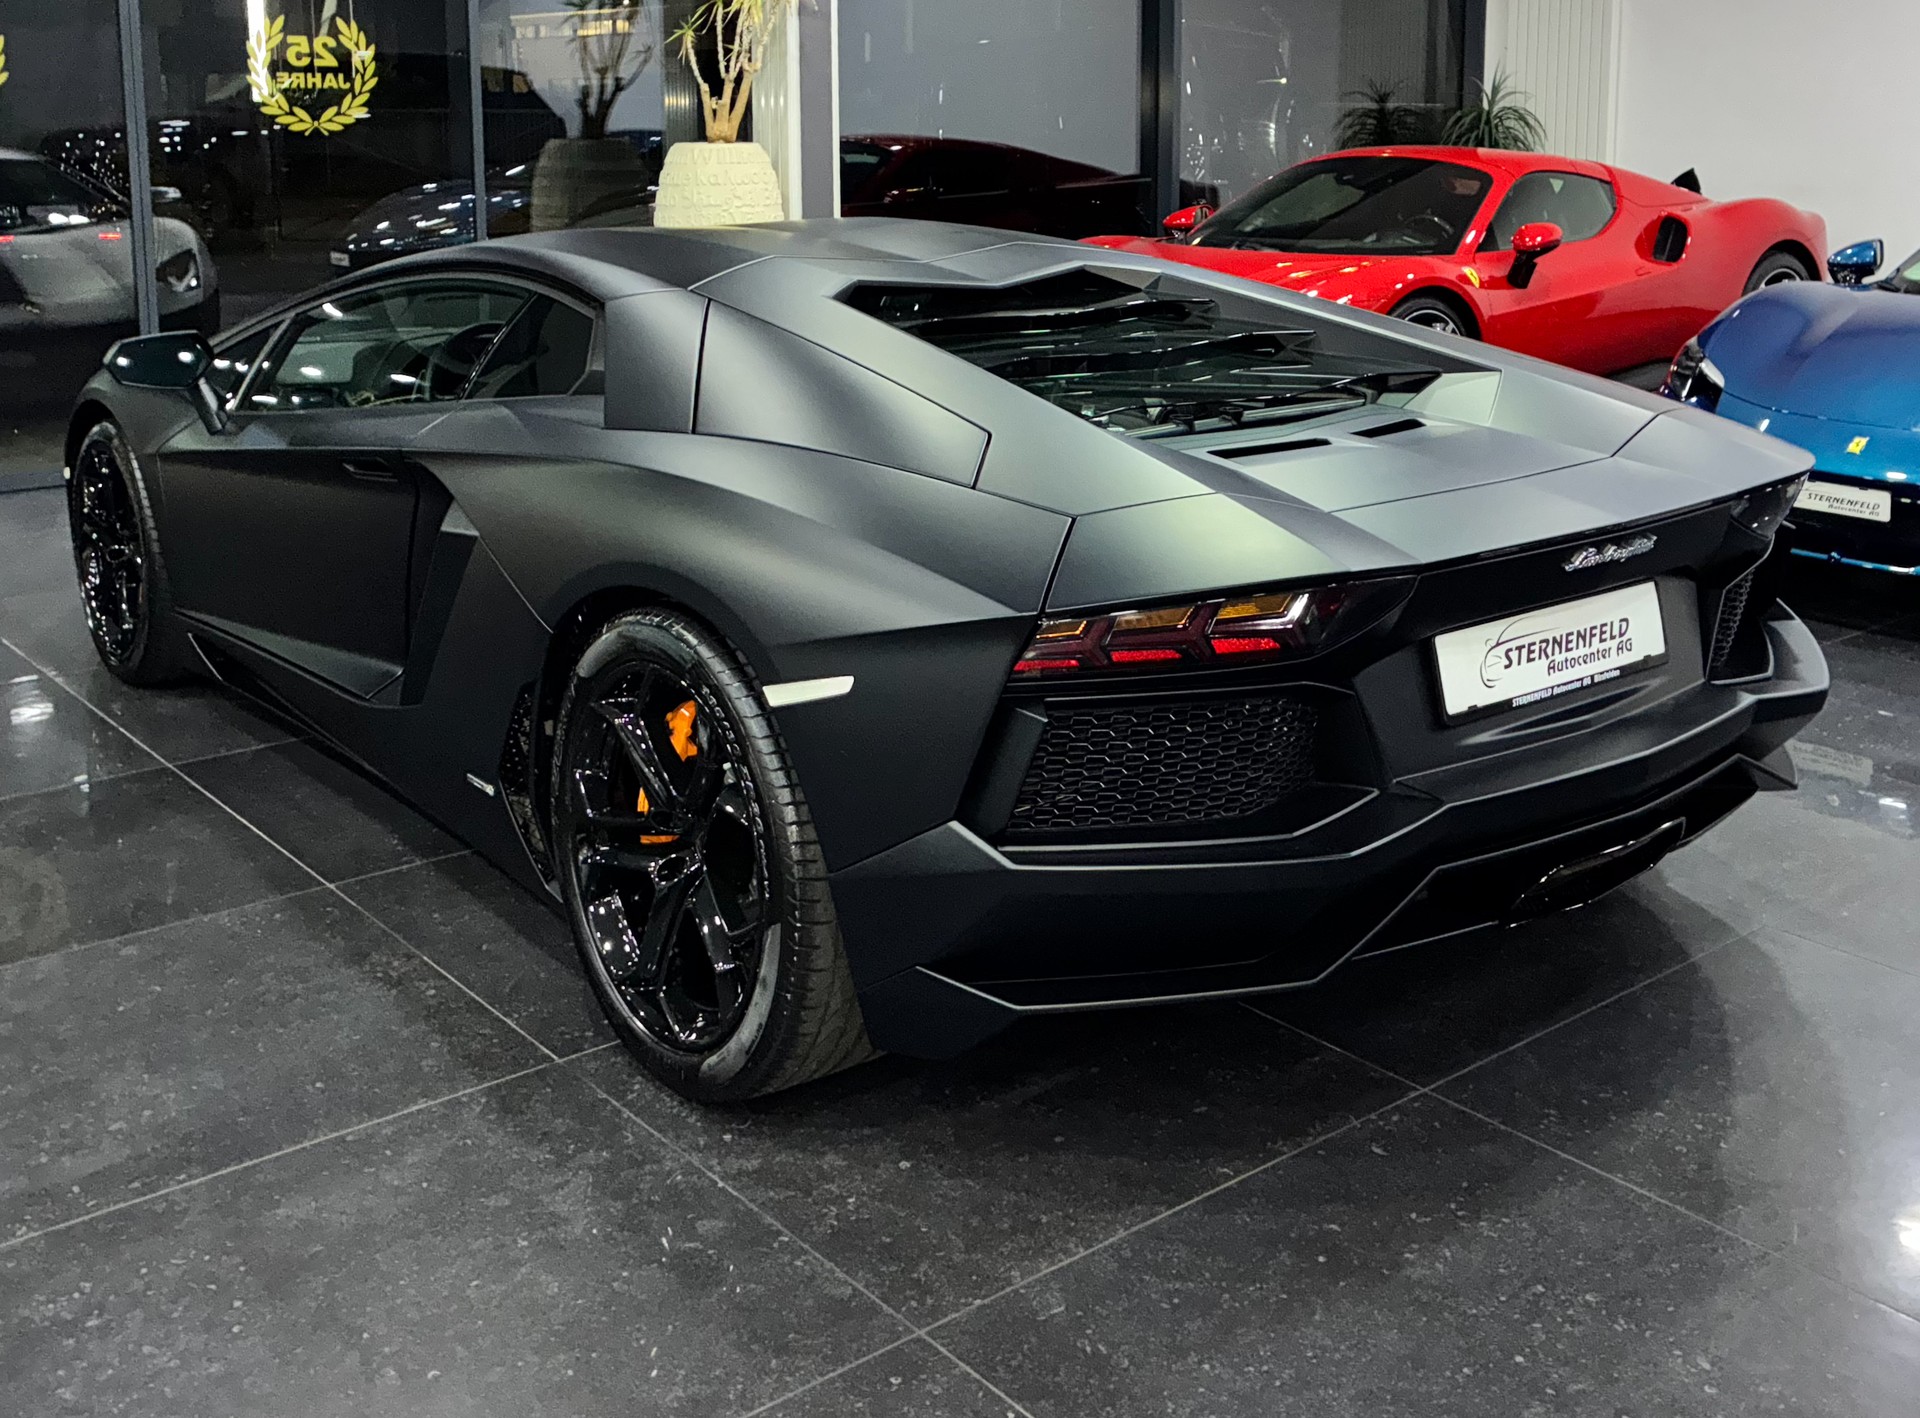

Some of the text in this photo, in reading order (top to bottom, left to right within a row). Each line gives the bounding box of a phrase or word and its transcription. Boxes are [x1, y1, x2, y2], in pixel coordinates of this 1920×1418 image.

[1807, 492, 1881, 512] STERNENFELD
[1828, 504, 1866, 515] Autocenter
[1503, 617, 1630, 670] STERNENFELD
[1546, 637, 1633, 676] Autocenter AG
[1511, 687, 1553, 708] STERNENFELD
[1553, 679, 1583, 696] Autocenter
